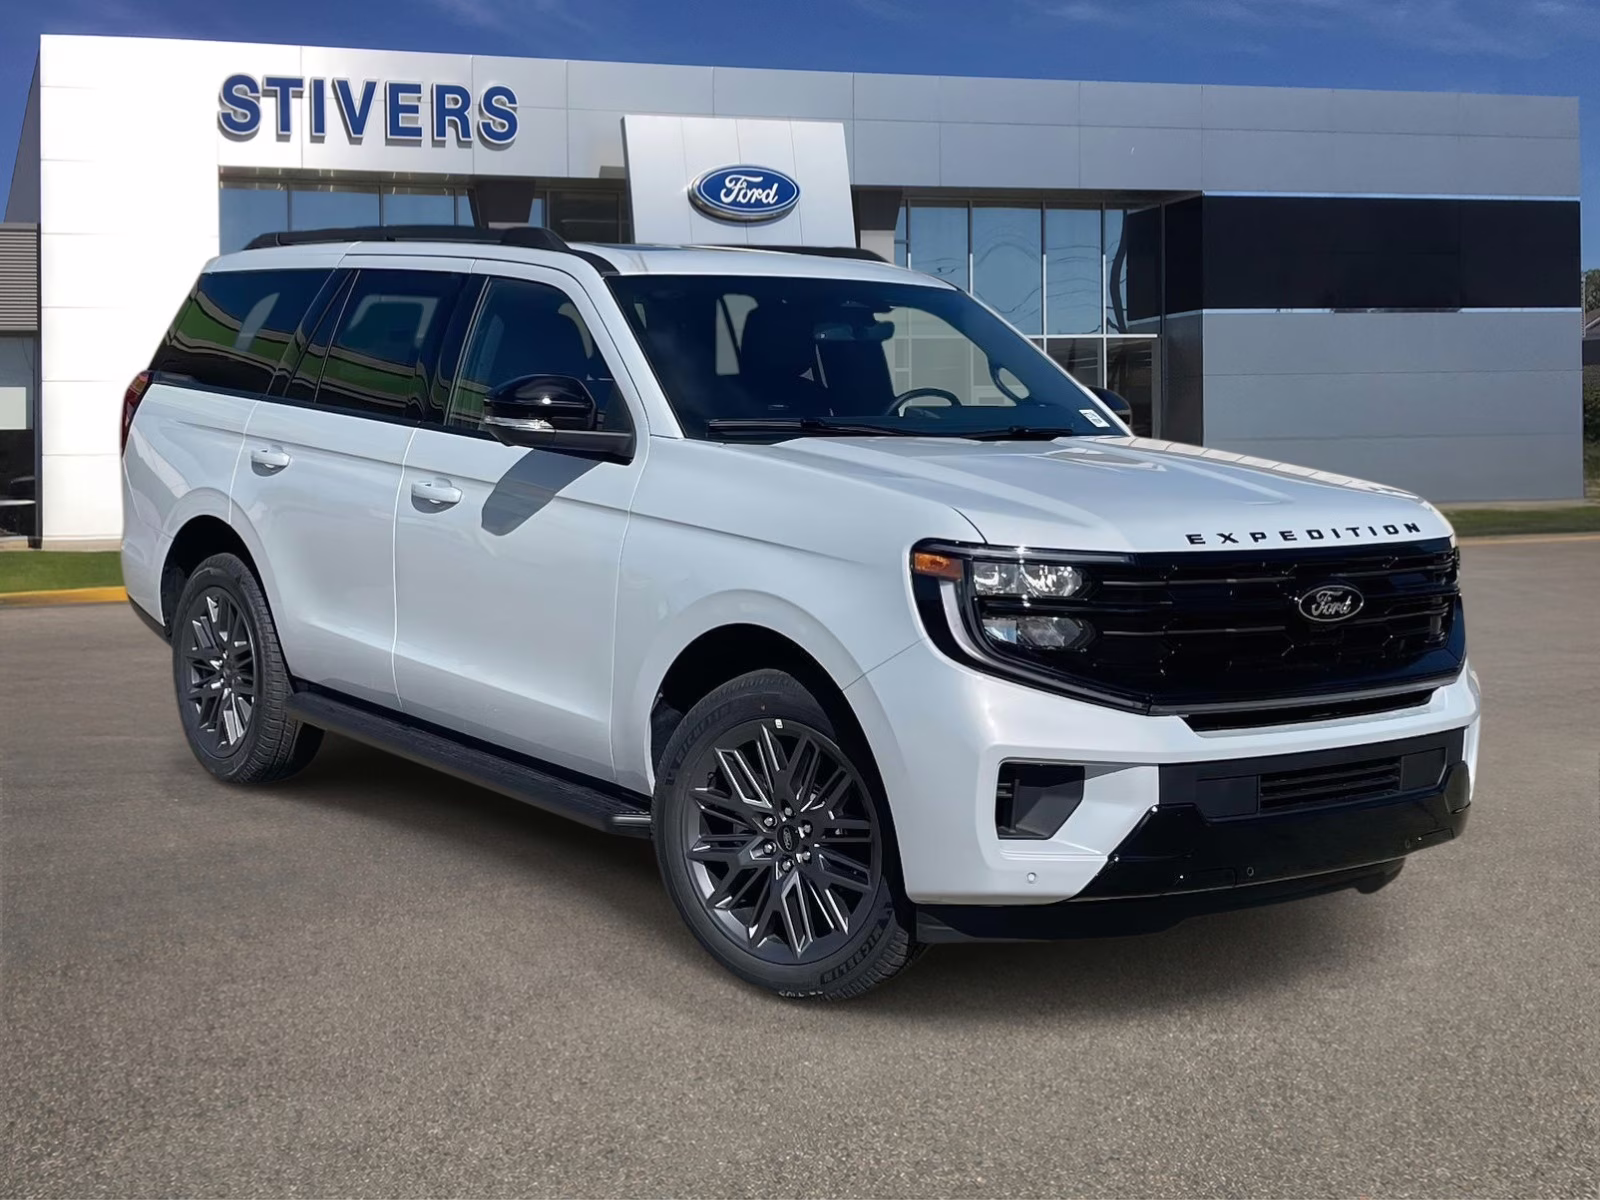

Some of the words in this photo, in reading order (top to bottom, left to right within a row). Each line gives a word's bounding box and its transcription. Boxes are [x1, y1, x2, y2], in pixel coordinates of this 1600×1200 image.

[217, 73, 519, 149] STIVERS
[720, 174, 779, 204] Ford
[1186, 523, 1421, 545] EXPEDITION
[1311, 590, 1352, 616] Ford
